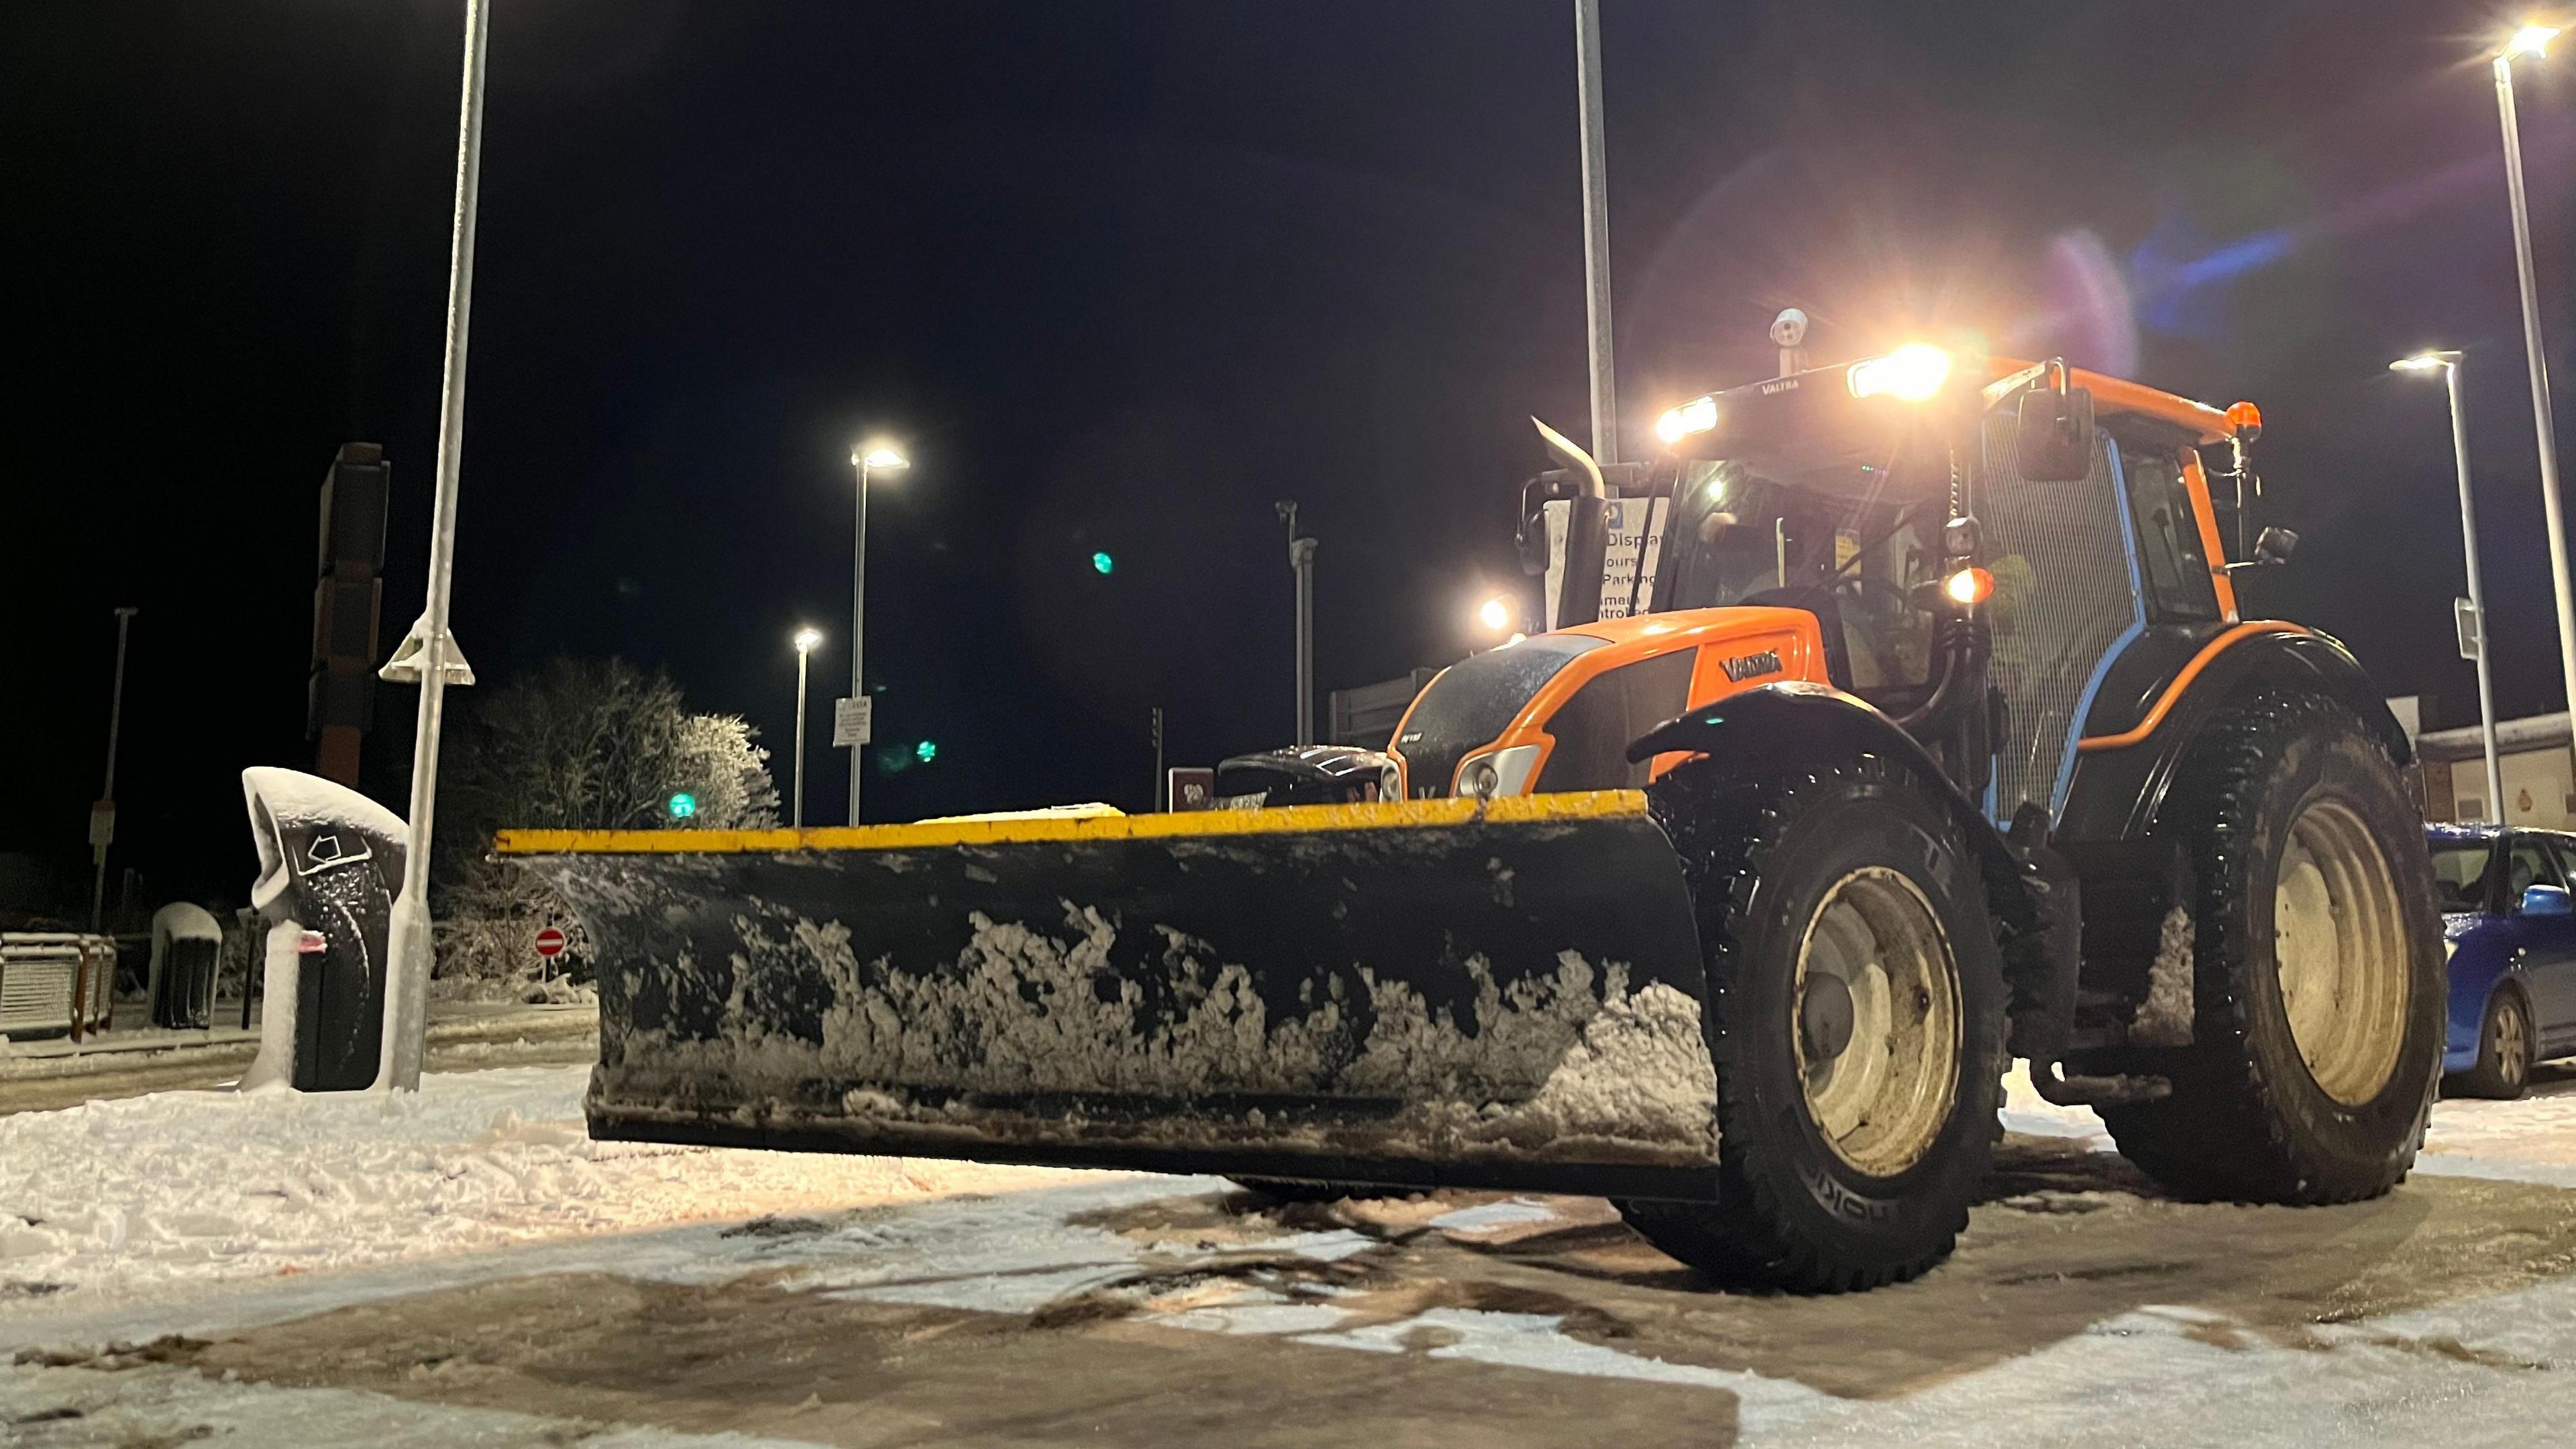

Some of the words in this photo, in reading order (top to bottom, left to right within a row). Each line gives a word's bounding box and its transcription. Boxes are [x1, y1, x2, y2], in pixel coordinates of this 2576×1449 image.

[1762, 380, 1799, 394] VALTRA
[1608, 533, 1662, 549] Dispa
[1607, 558, 1637, 568] ours
[1603, 574, 1655, 586] Parkng
